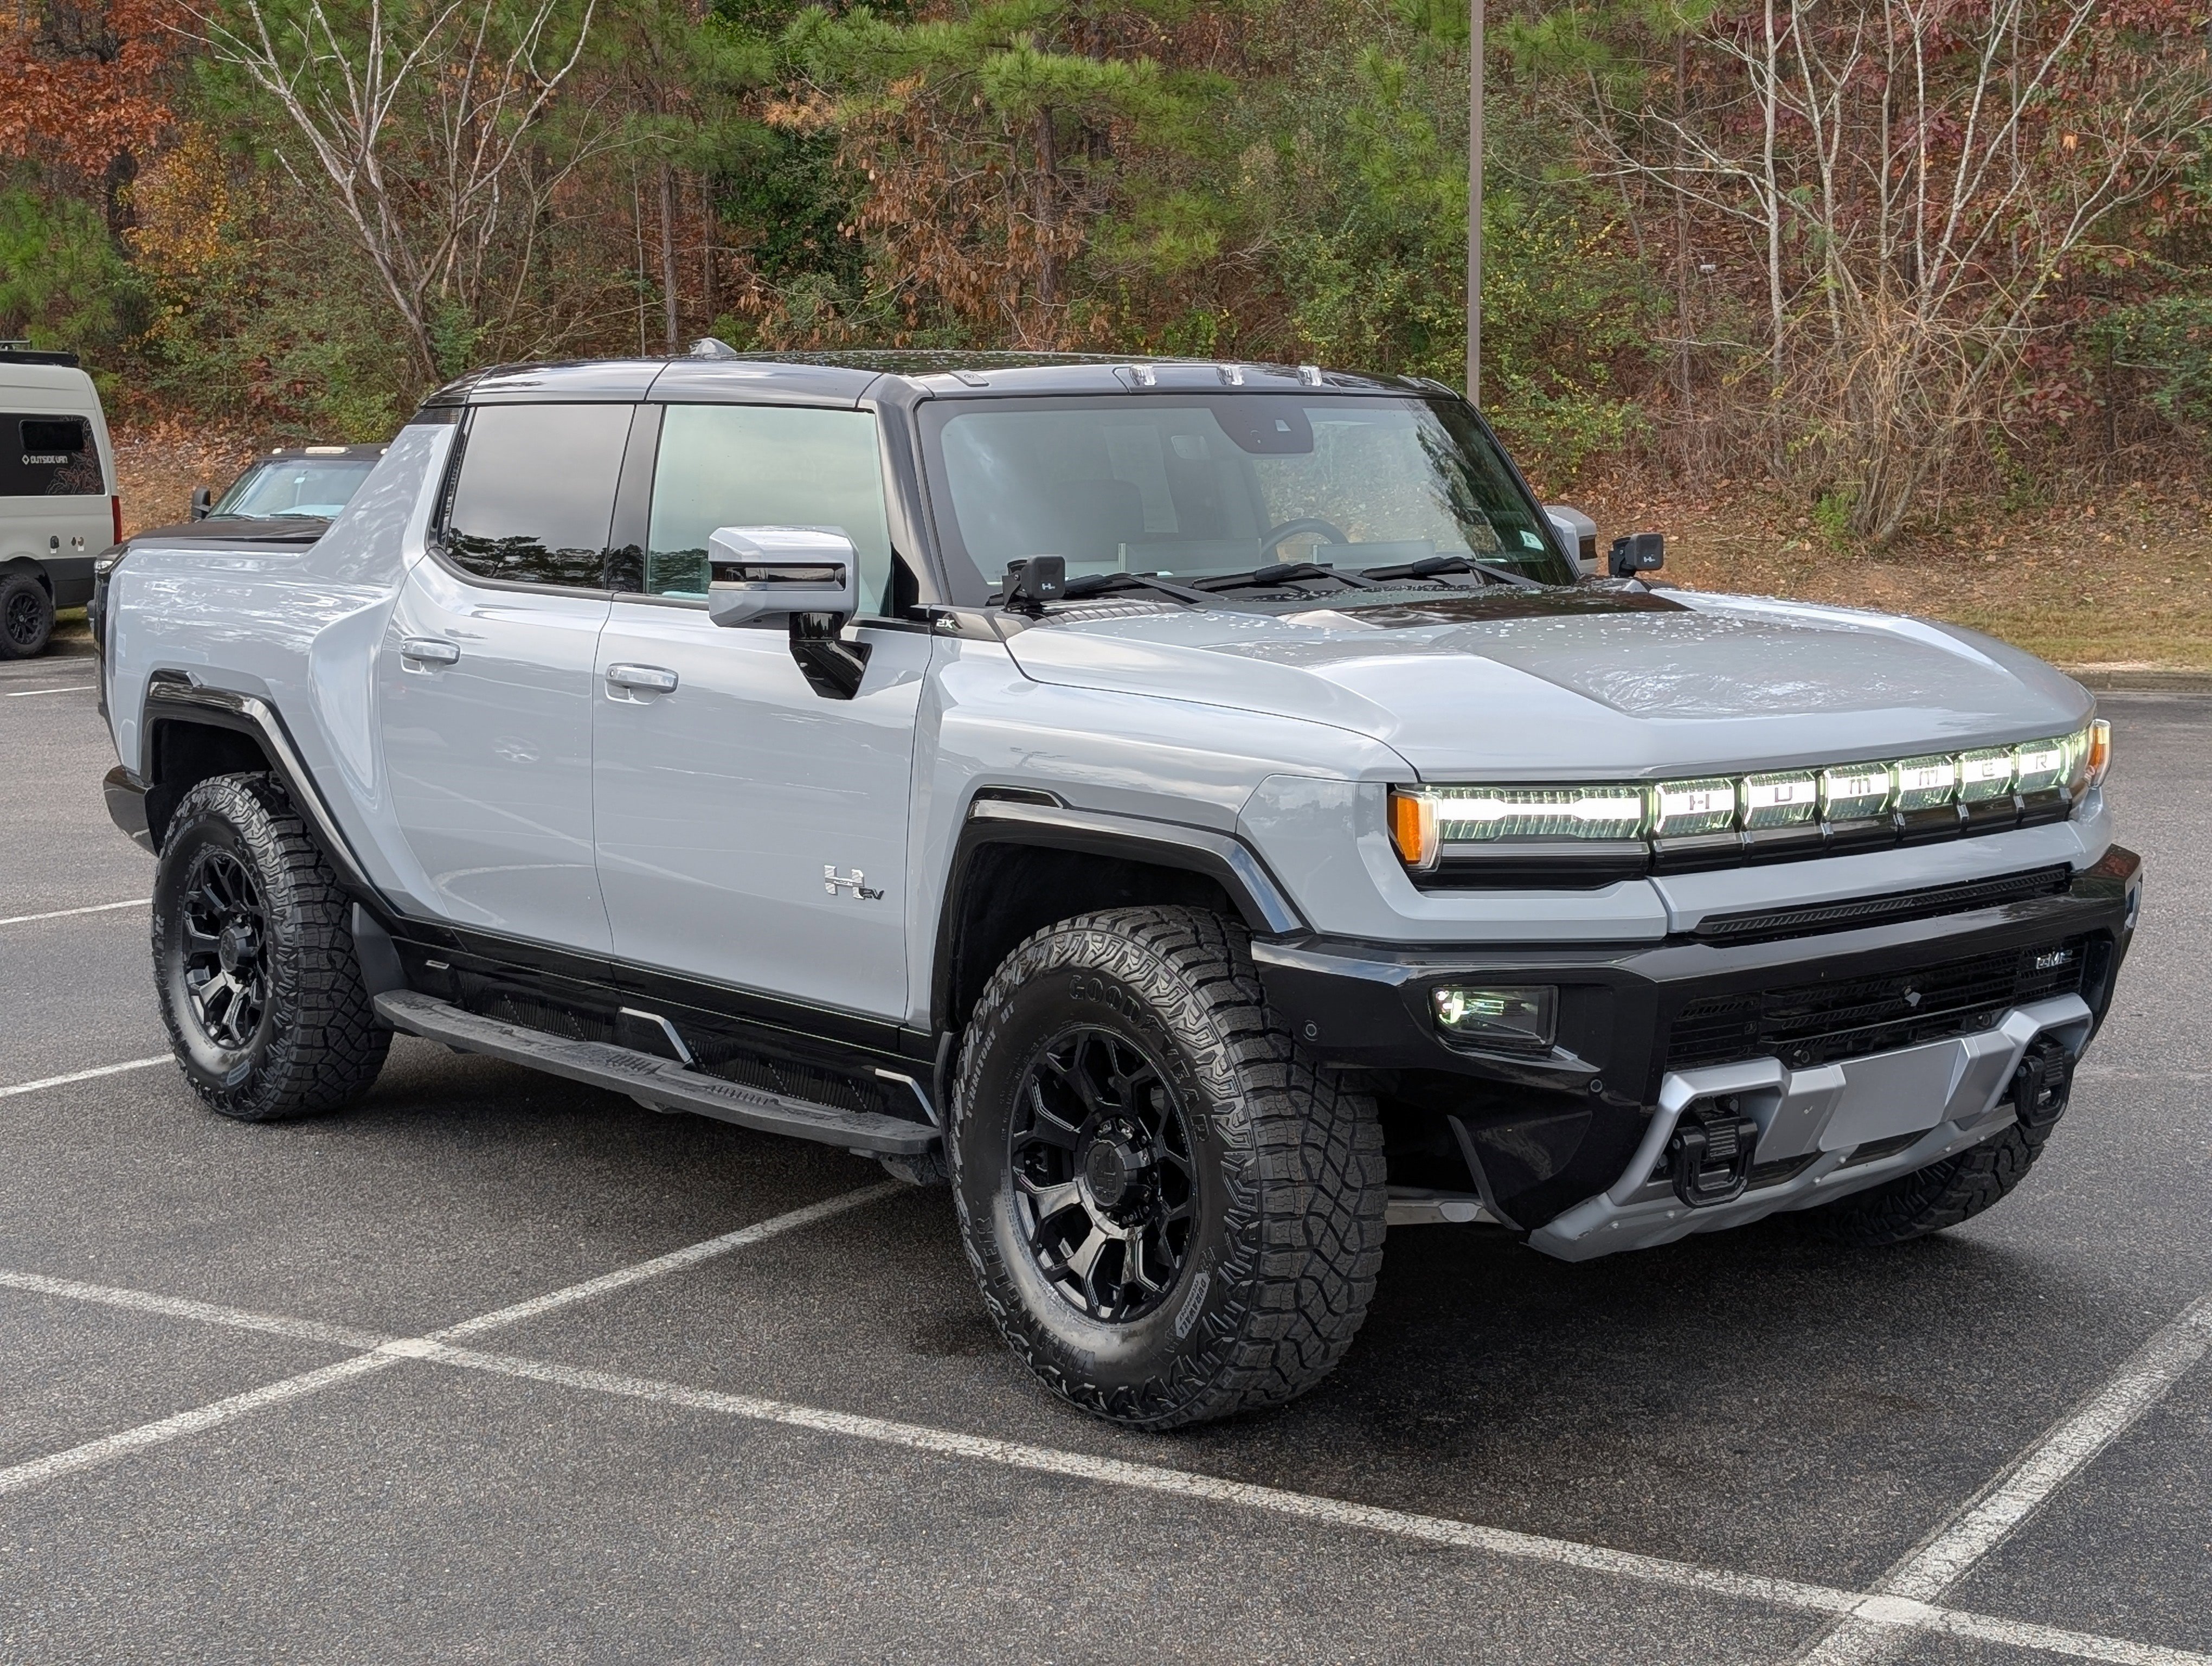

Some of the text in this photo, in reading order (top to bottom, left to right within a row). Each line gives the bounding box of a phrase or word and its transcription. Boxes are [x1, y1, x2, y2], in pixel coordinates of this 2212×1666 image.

[936, 618, 955, 629] 2X
[1689, 754, 2048, 811] HUMMER
[824, 864, 864, 900] H
[966, 1026, 996, 1119] TERRITORY
[1068, 975, 1211, 1142] GOODYEAR
[1180, 1278, 1206, 1335] DURAWALL
